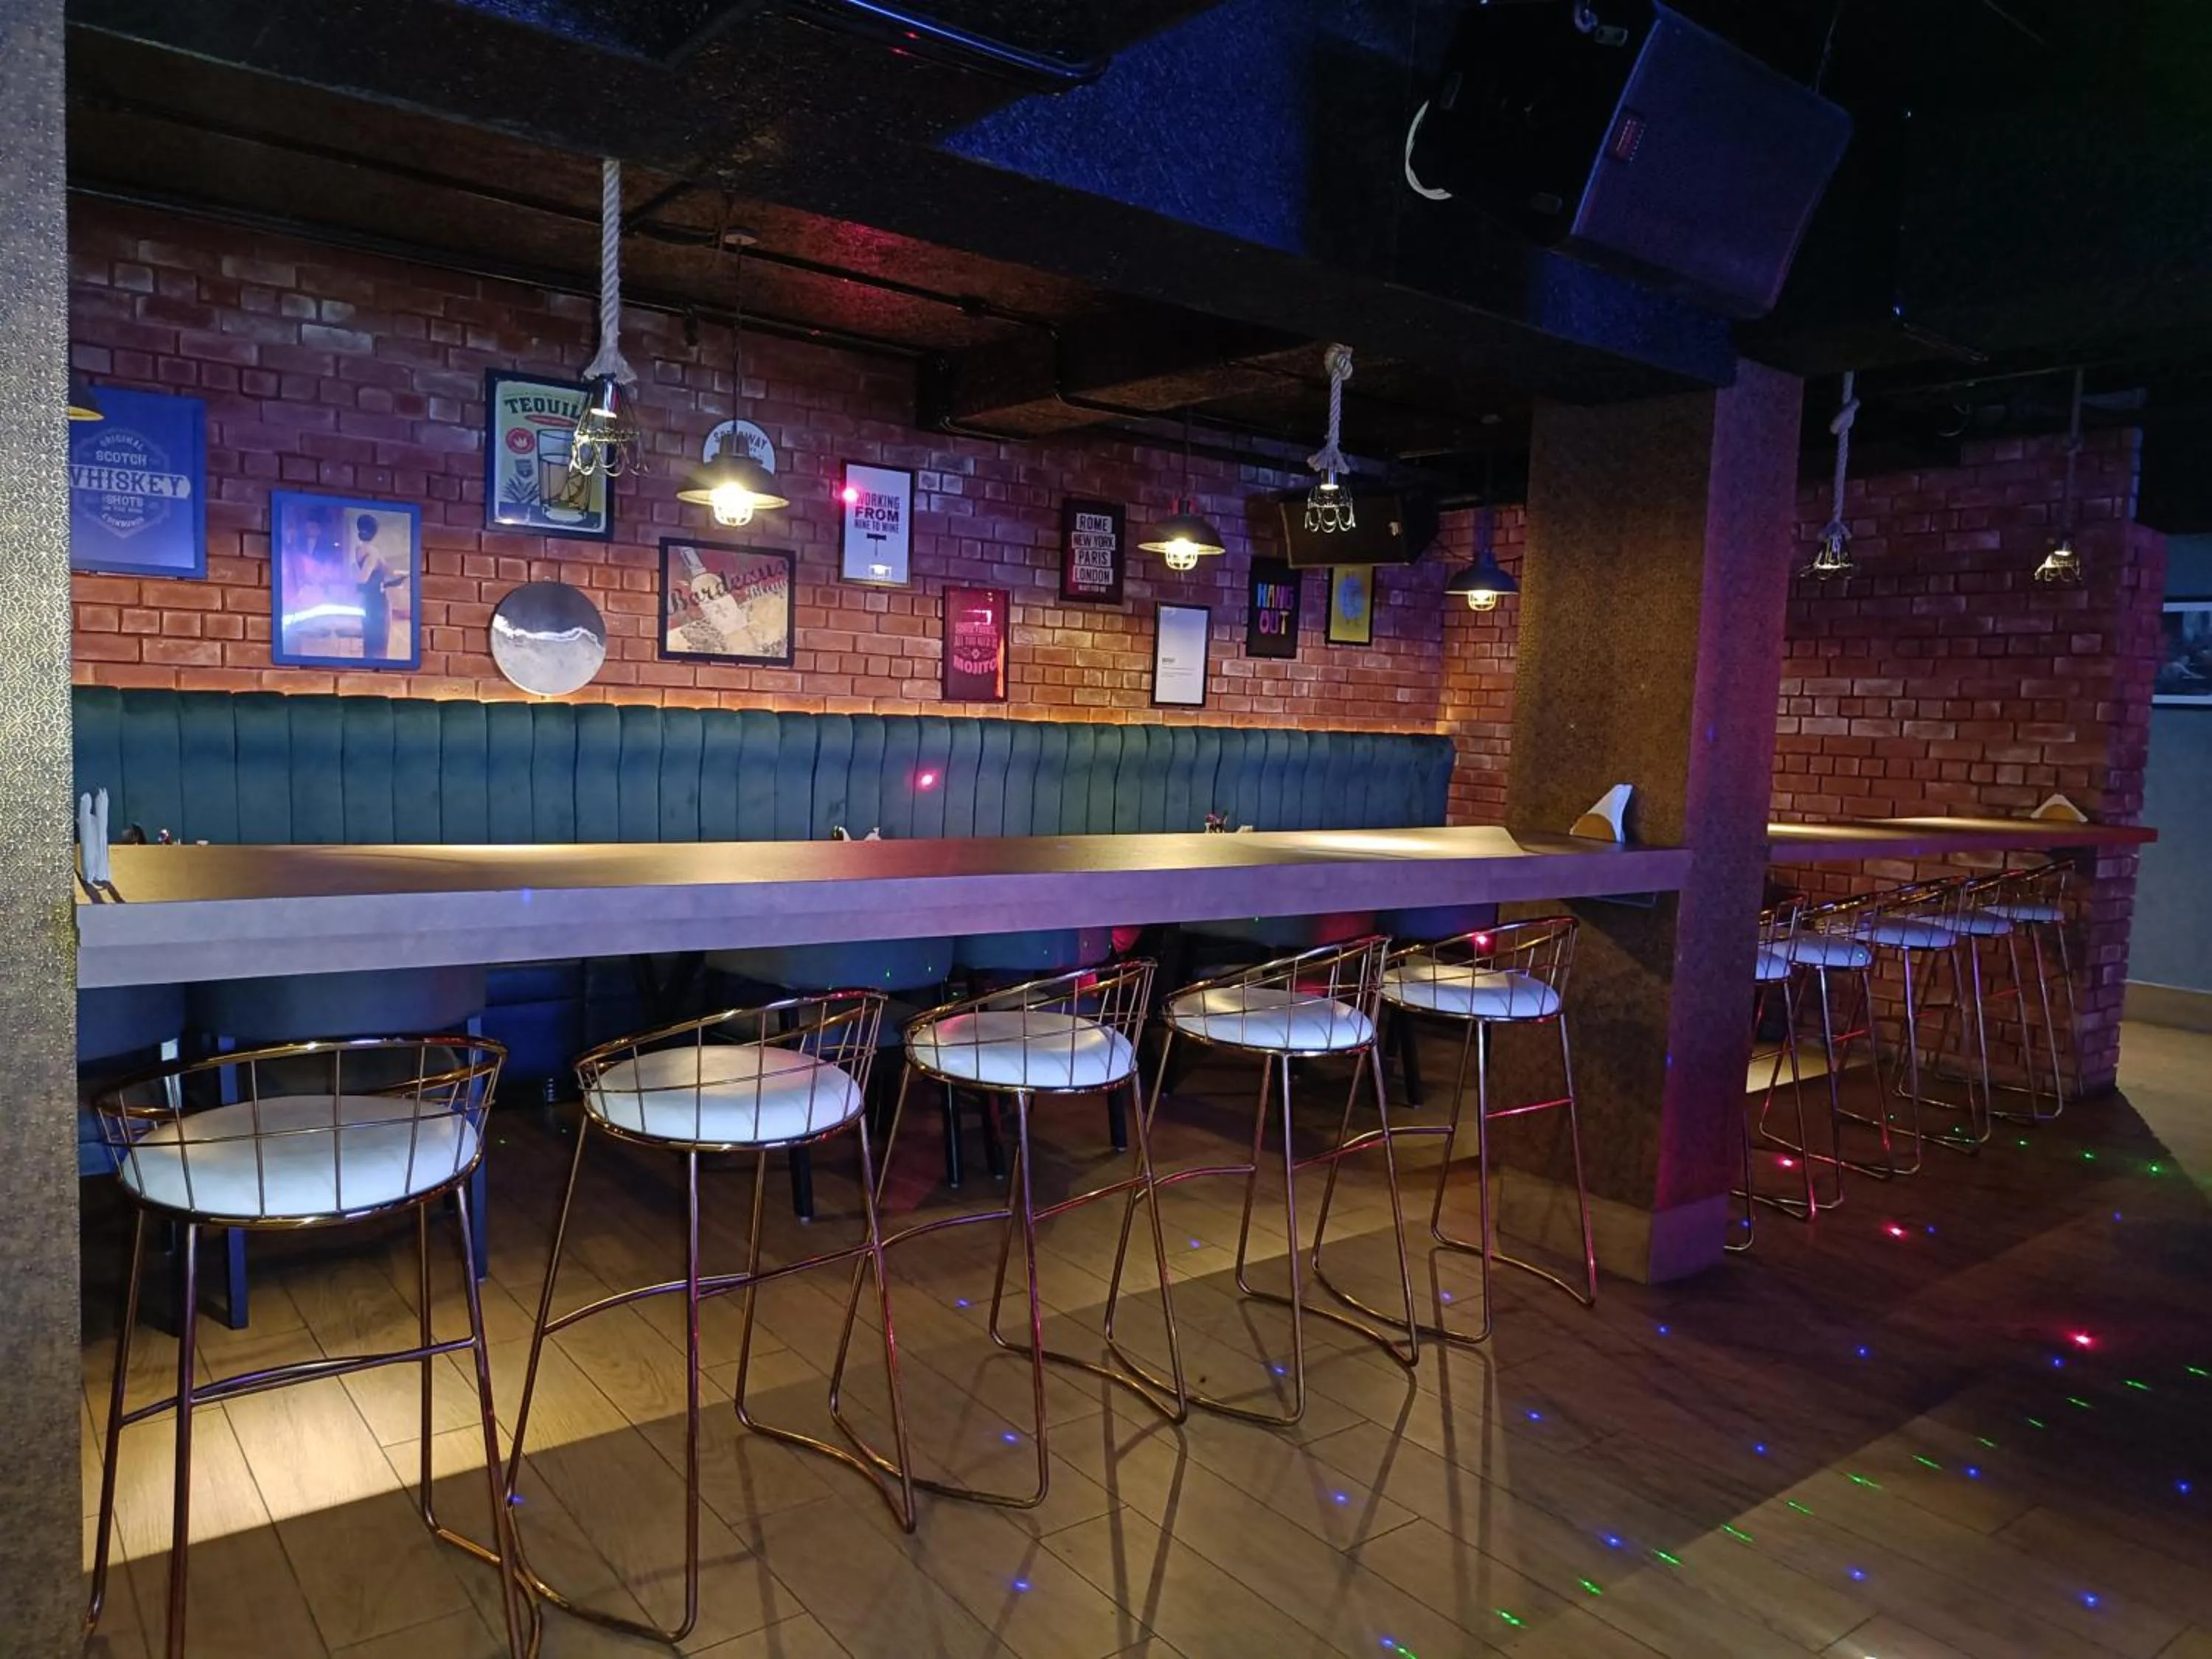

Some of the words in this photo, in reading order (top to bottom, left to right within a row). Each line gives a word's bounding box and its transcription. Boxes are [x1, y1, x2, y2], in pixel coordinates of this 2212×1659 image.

[504, 397, 584, 420] TEQUIL
[95, 450, 148, 466] SCOTCH
[105, 495, 144, 507] SHOTS
[857, 493, 900, 509] WORKING
[855, 506, 899, 522] FROM
[1079, 515, 1109, 532] ROME
[1074, 534, 1091, 546] NEW
[1093, 535, 1114, 549] YORK
[1079, 550, 1108, 566] PARIS
[1074, 567, 1110, 583] LONDON
[1257, 583, 1294, 609] HANG
[1259, 610, 1289, 635] OUT
